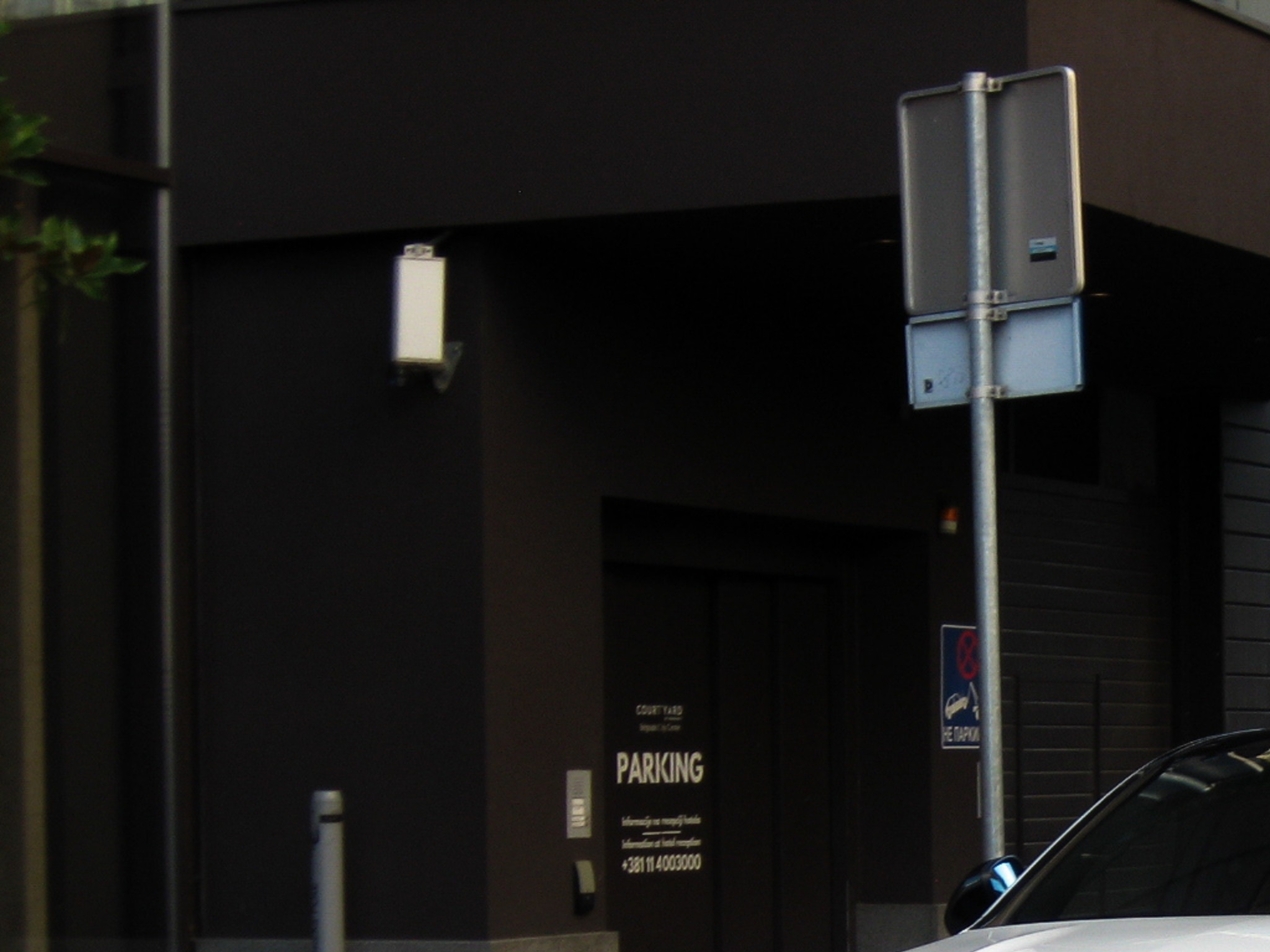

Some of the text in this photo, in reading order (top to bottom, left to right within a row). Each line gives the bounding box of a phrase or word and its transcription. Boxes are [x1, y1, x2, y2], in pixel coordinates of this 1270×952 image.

[616, 751, 705, 784] PARKING
[621, 853, 702, 874] +381 11 4003000
